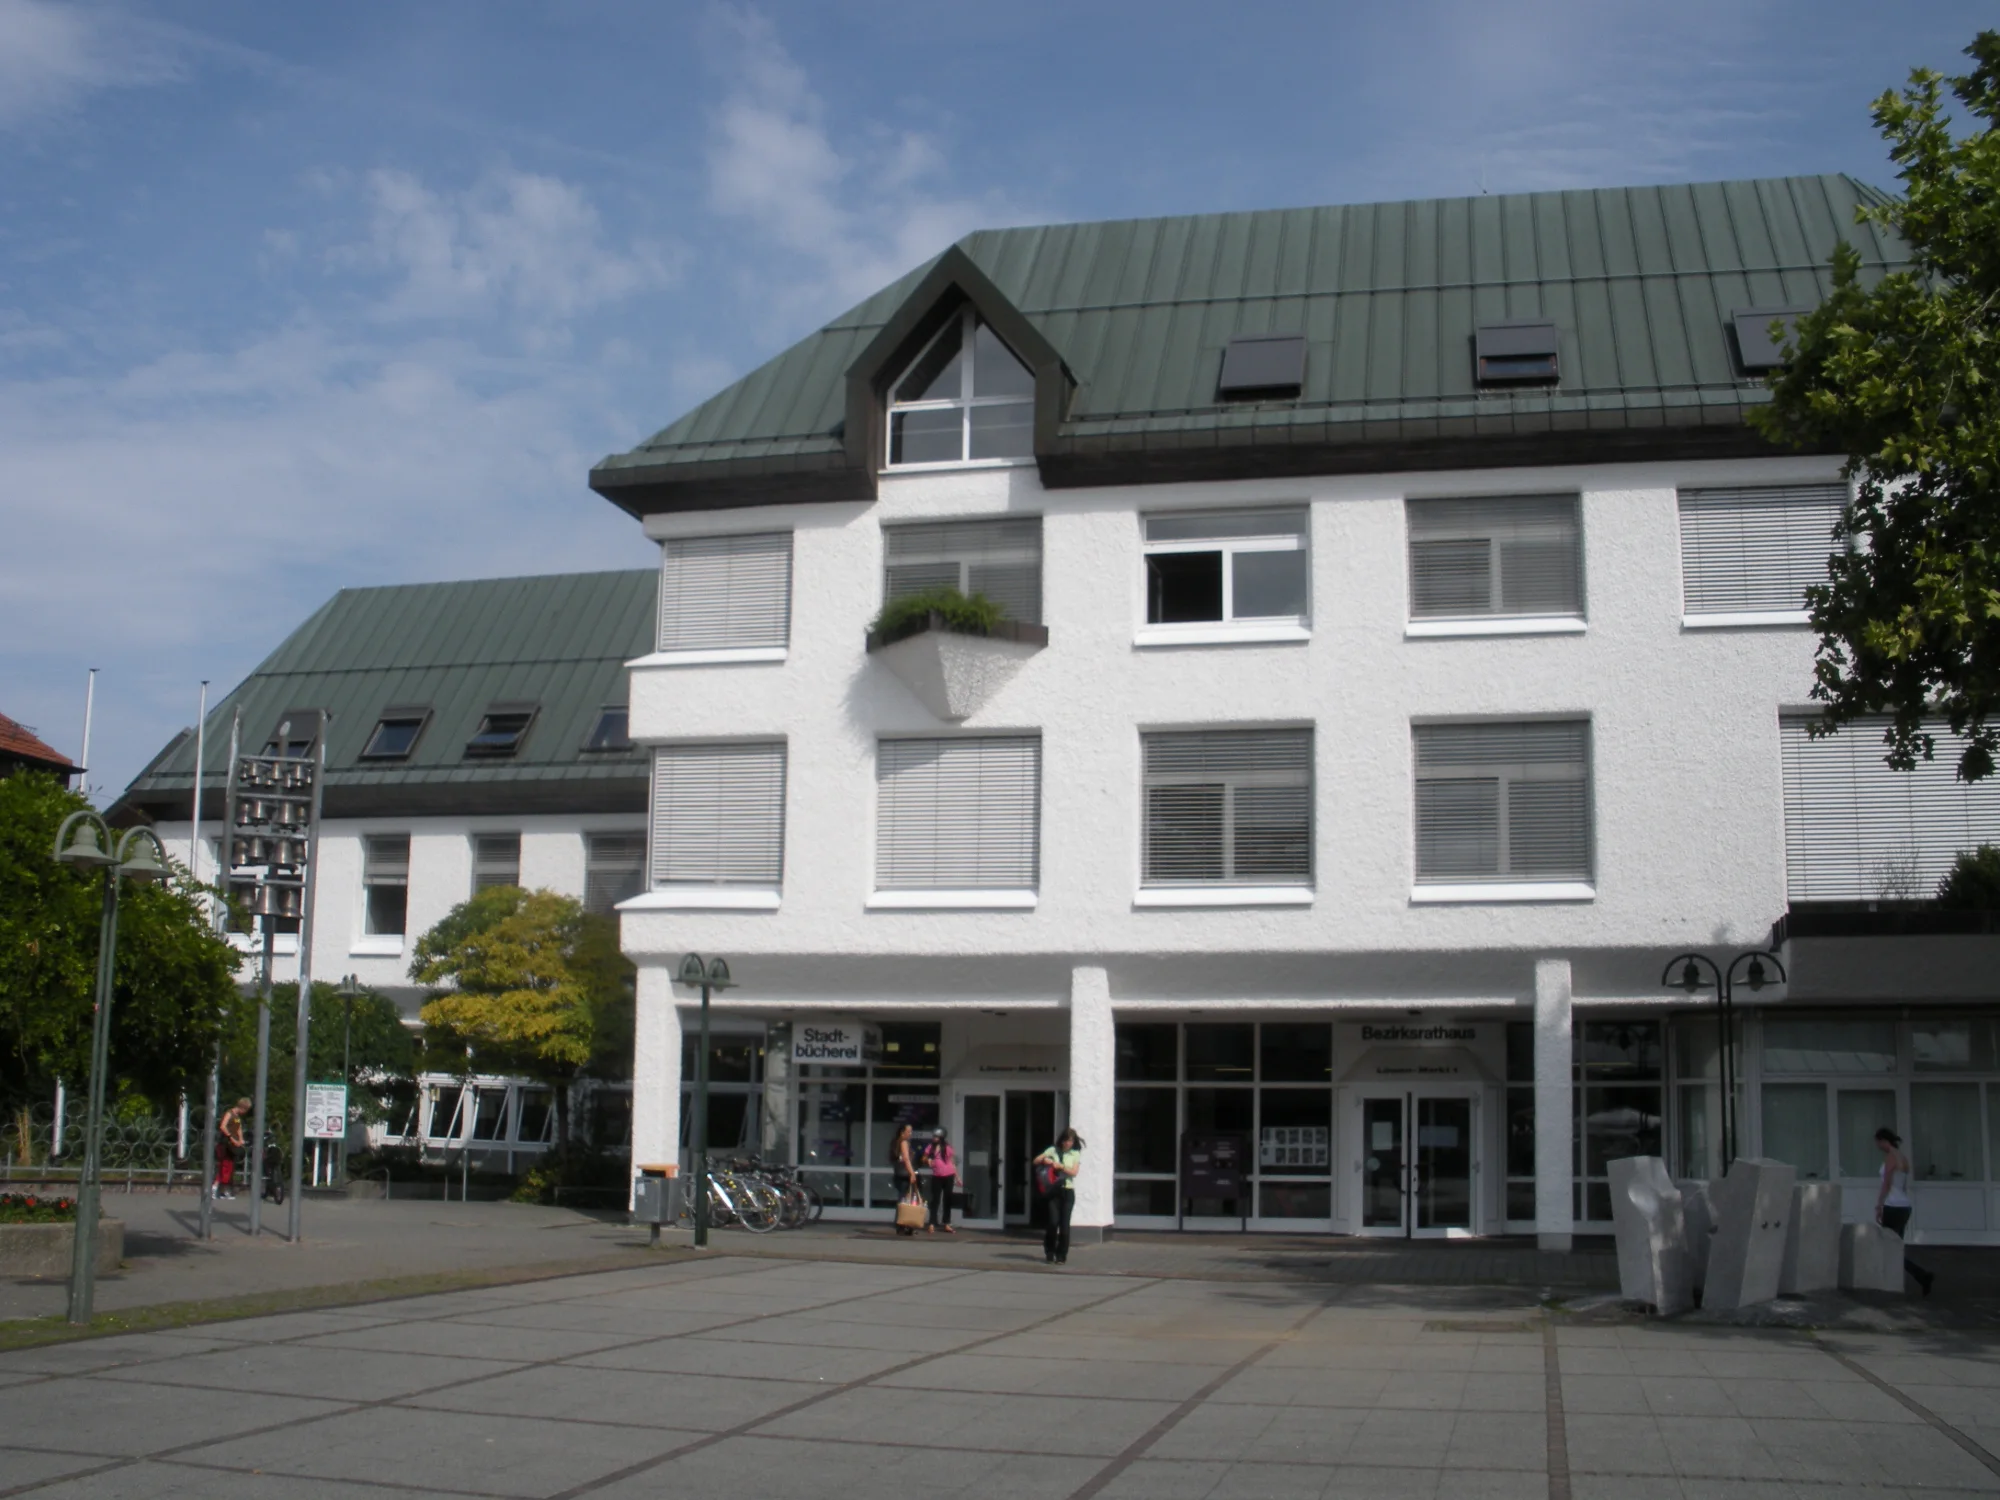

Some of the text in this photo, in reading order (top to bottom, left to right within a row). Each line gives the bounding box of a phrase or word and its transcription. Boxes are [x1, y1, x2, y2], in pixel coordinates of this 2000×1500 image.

[804, 1028, 850, 1042] Stadt-
[1361, 1026, 1475, 1040] Bezirksrathaus
[796, 1043, 857, 1058] bücherei
